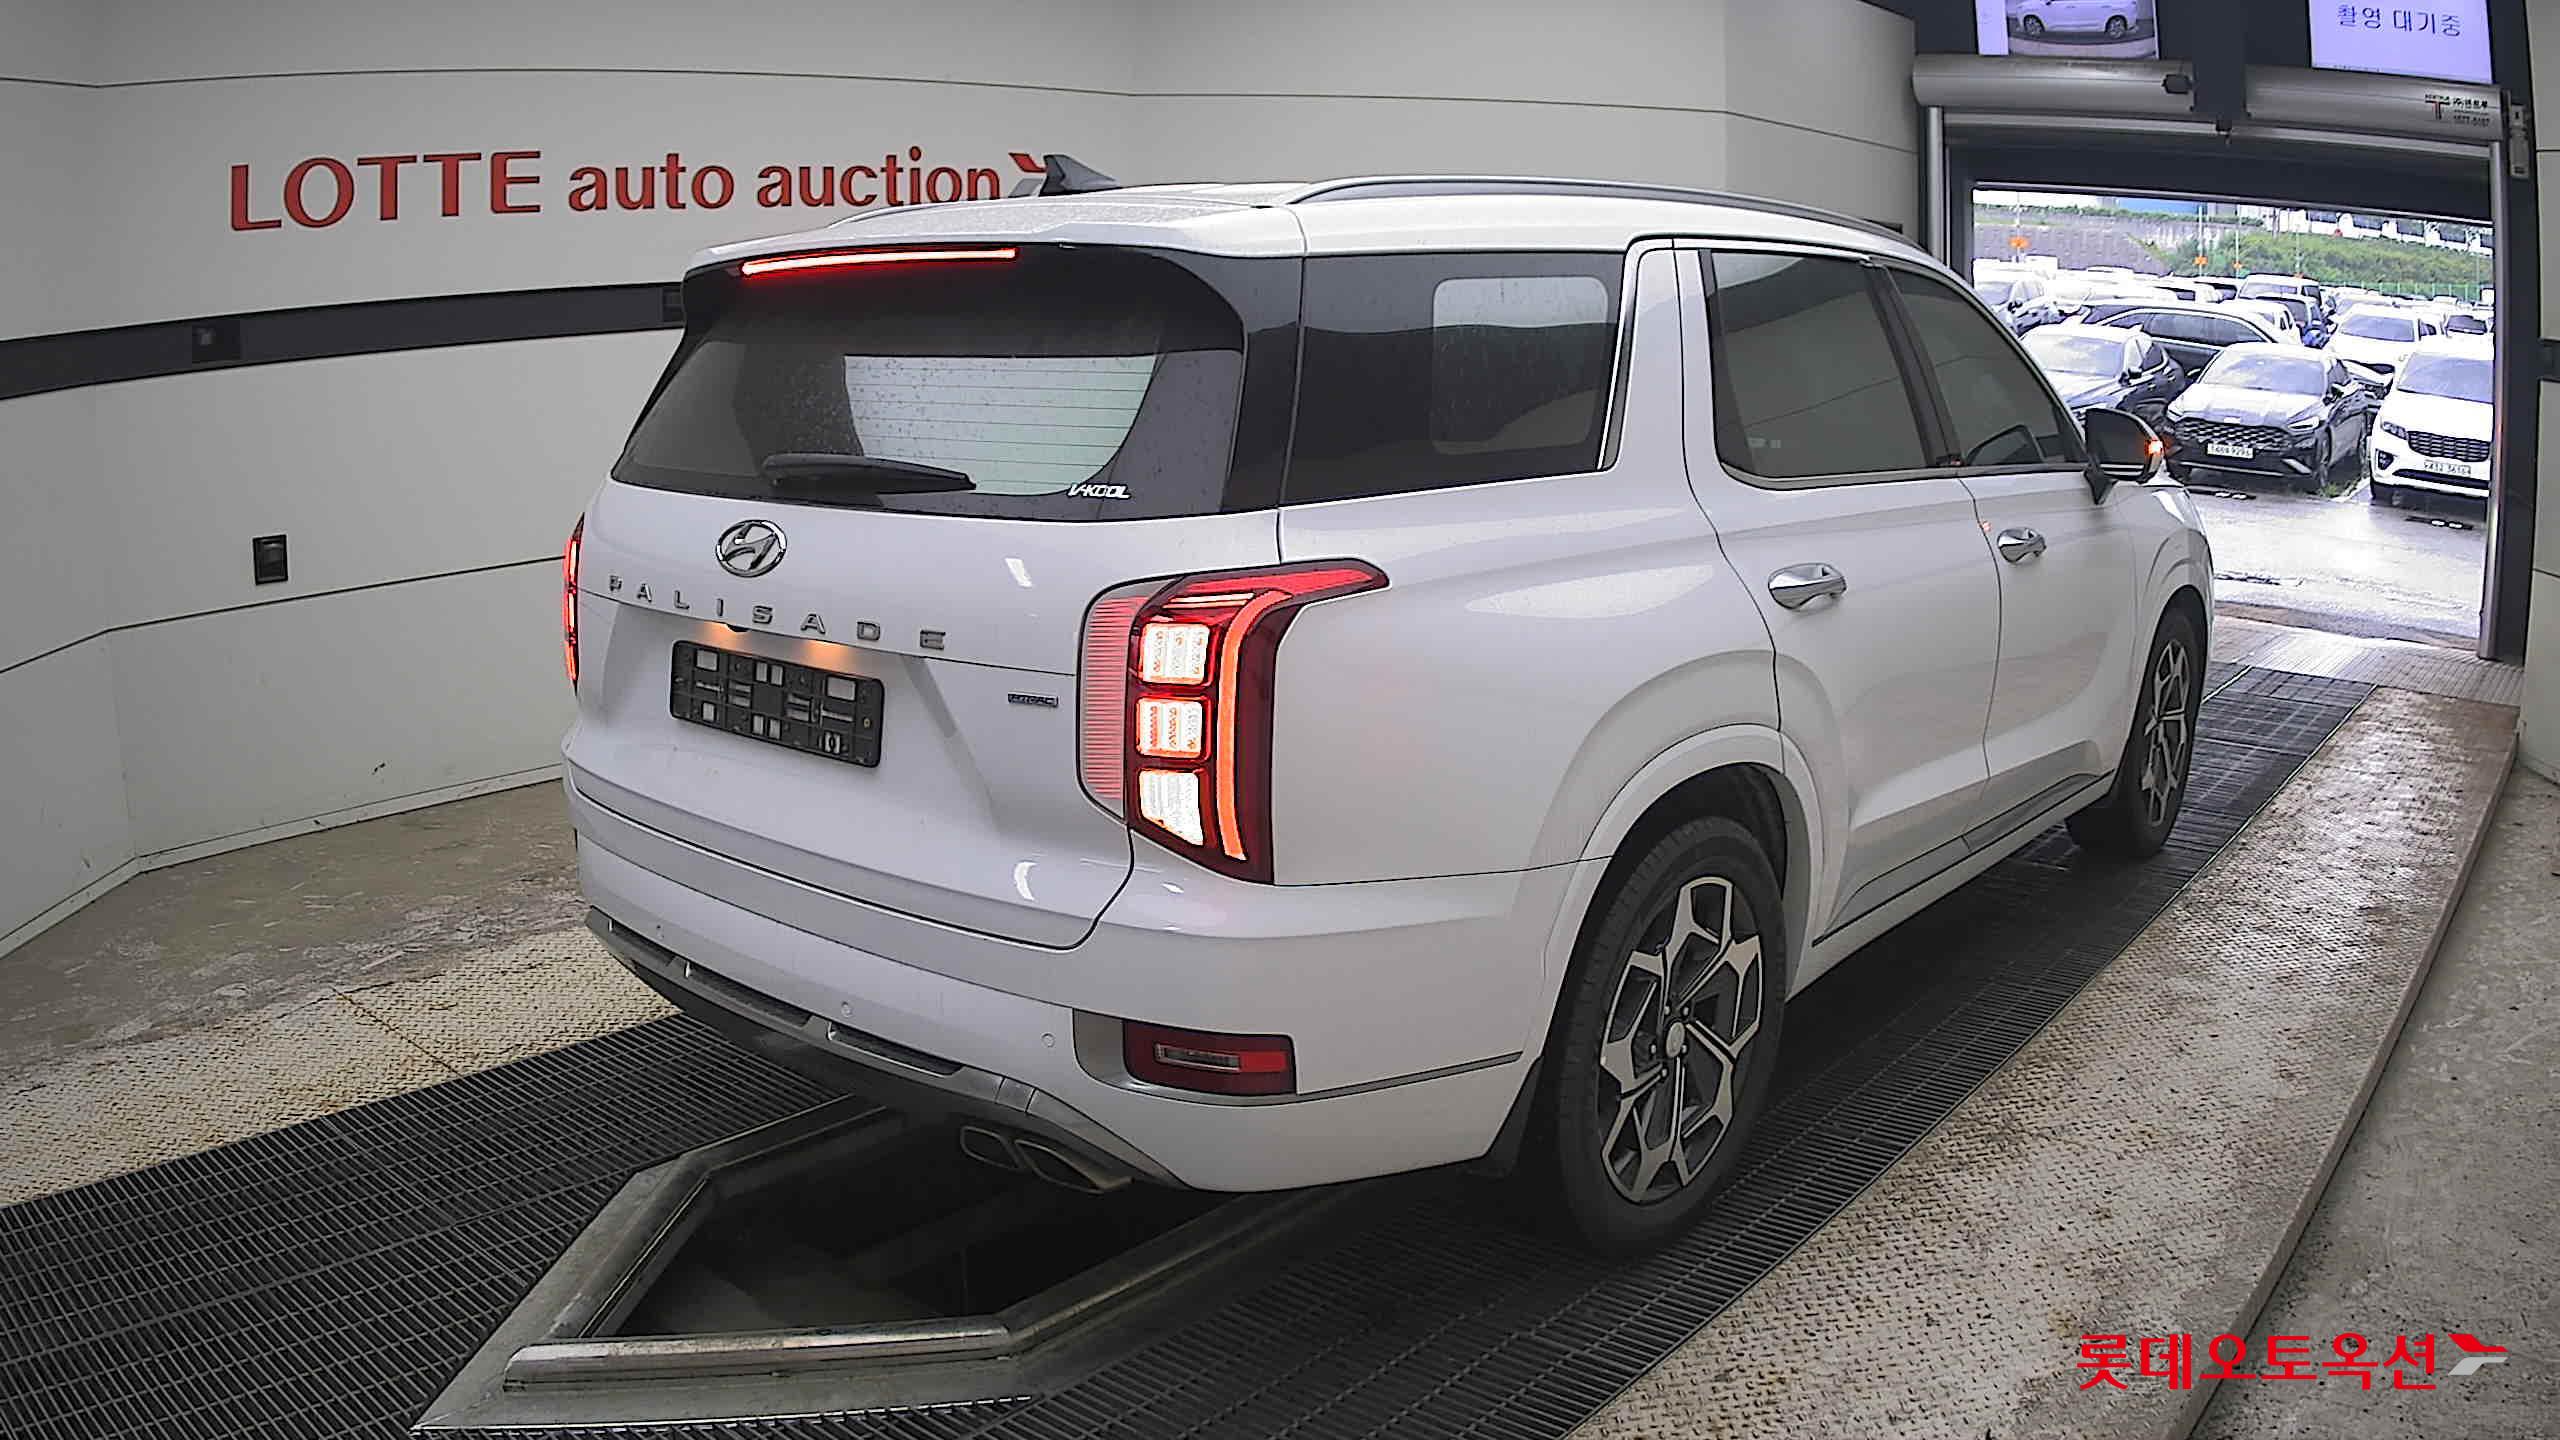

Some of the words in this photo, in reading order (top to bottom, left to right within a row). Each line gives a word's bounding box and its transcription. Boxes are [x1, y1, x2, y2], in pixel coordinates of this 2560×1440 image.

[2338, 5, 2381, 29] 촬영
[2393, 10, 2460, 37] 대기중
[229, 149, 541, 232] LOTTE
[568, 152, 735, 211] auto
[757, 146, 1000, 207] auction
[1067, 483, 1131, 499] V-KOOL
[609, 575, 946, 650] PALISADE
